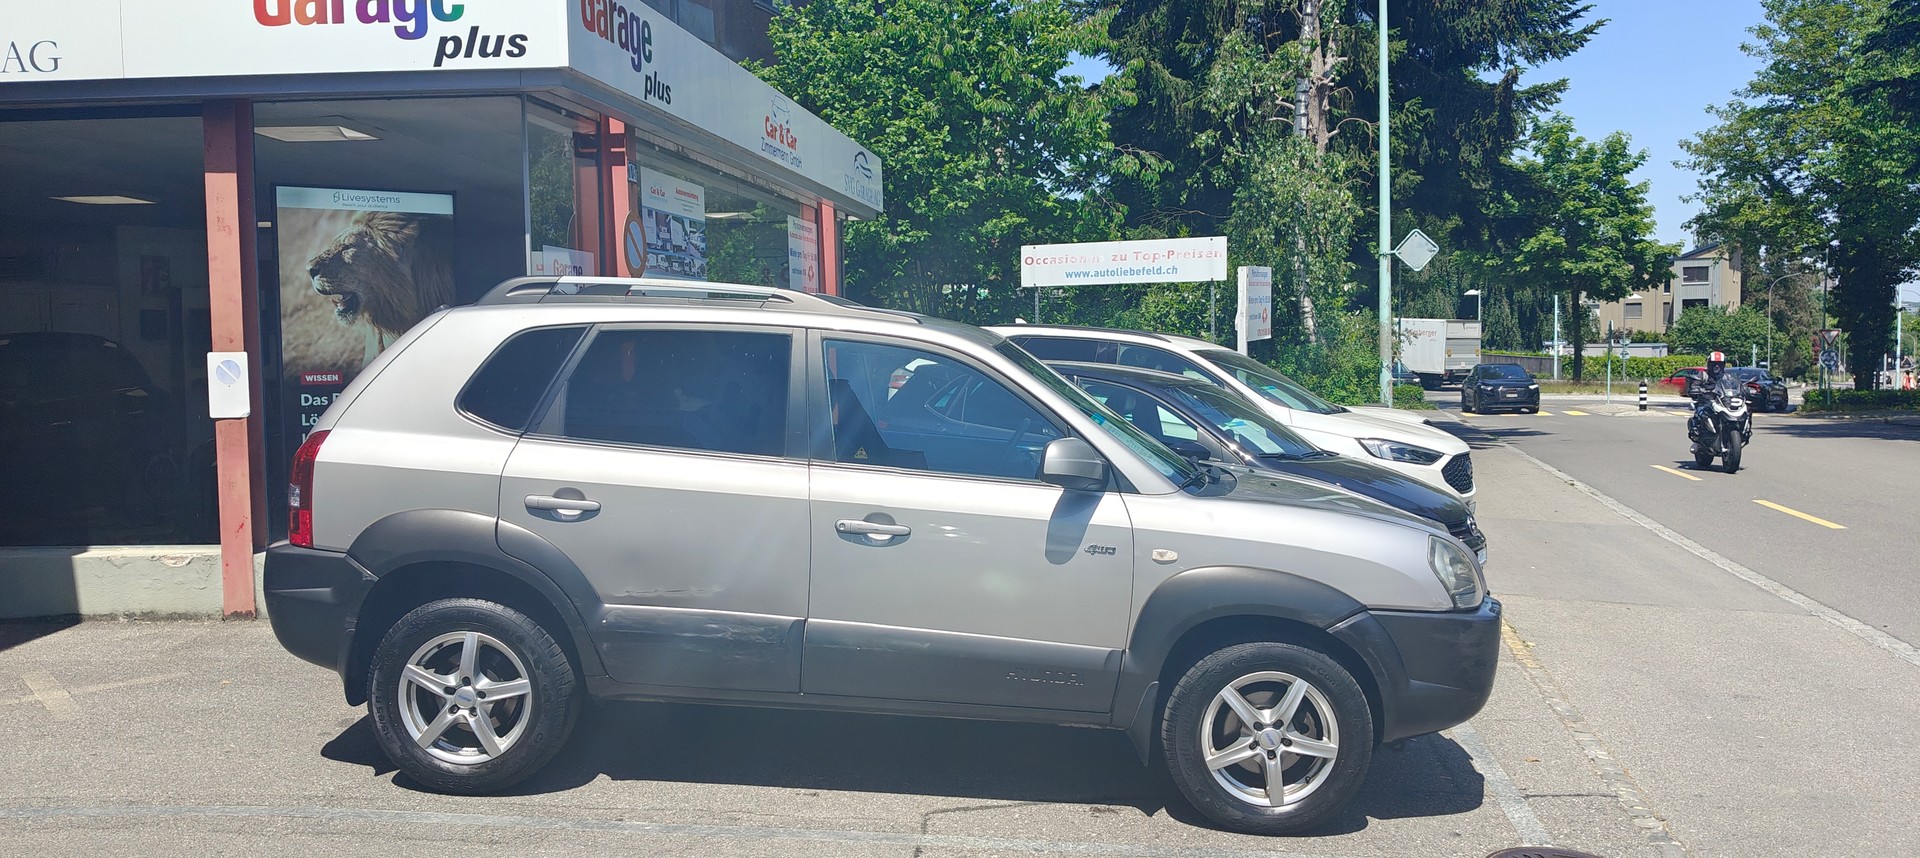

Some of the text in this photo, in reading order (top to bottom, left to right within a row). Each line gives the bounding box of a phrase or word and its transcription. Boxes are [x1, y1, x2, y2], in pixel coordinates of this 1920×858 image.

[433, 26, 528, 67] plus
[0, 40, 63, 73] AG
[644, 71, 672, 105] plus
[765, 116, 797, 151] Car & Car
[342, 193, 401, 204] Livesystems
[1065, 265, 1178, 278] www.autoliebefeld.ch
[305, 374, 339, 382] WISSEN
[300, 393, 329, 406] Das
[301, 413, 321, 426] Lö
